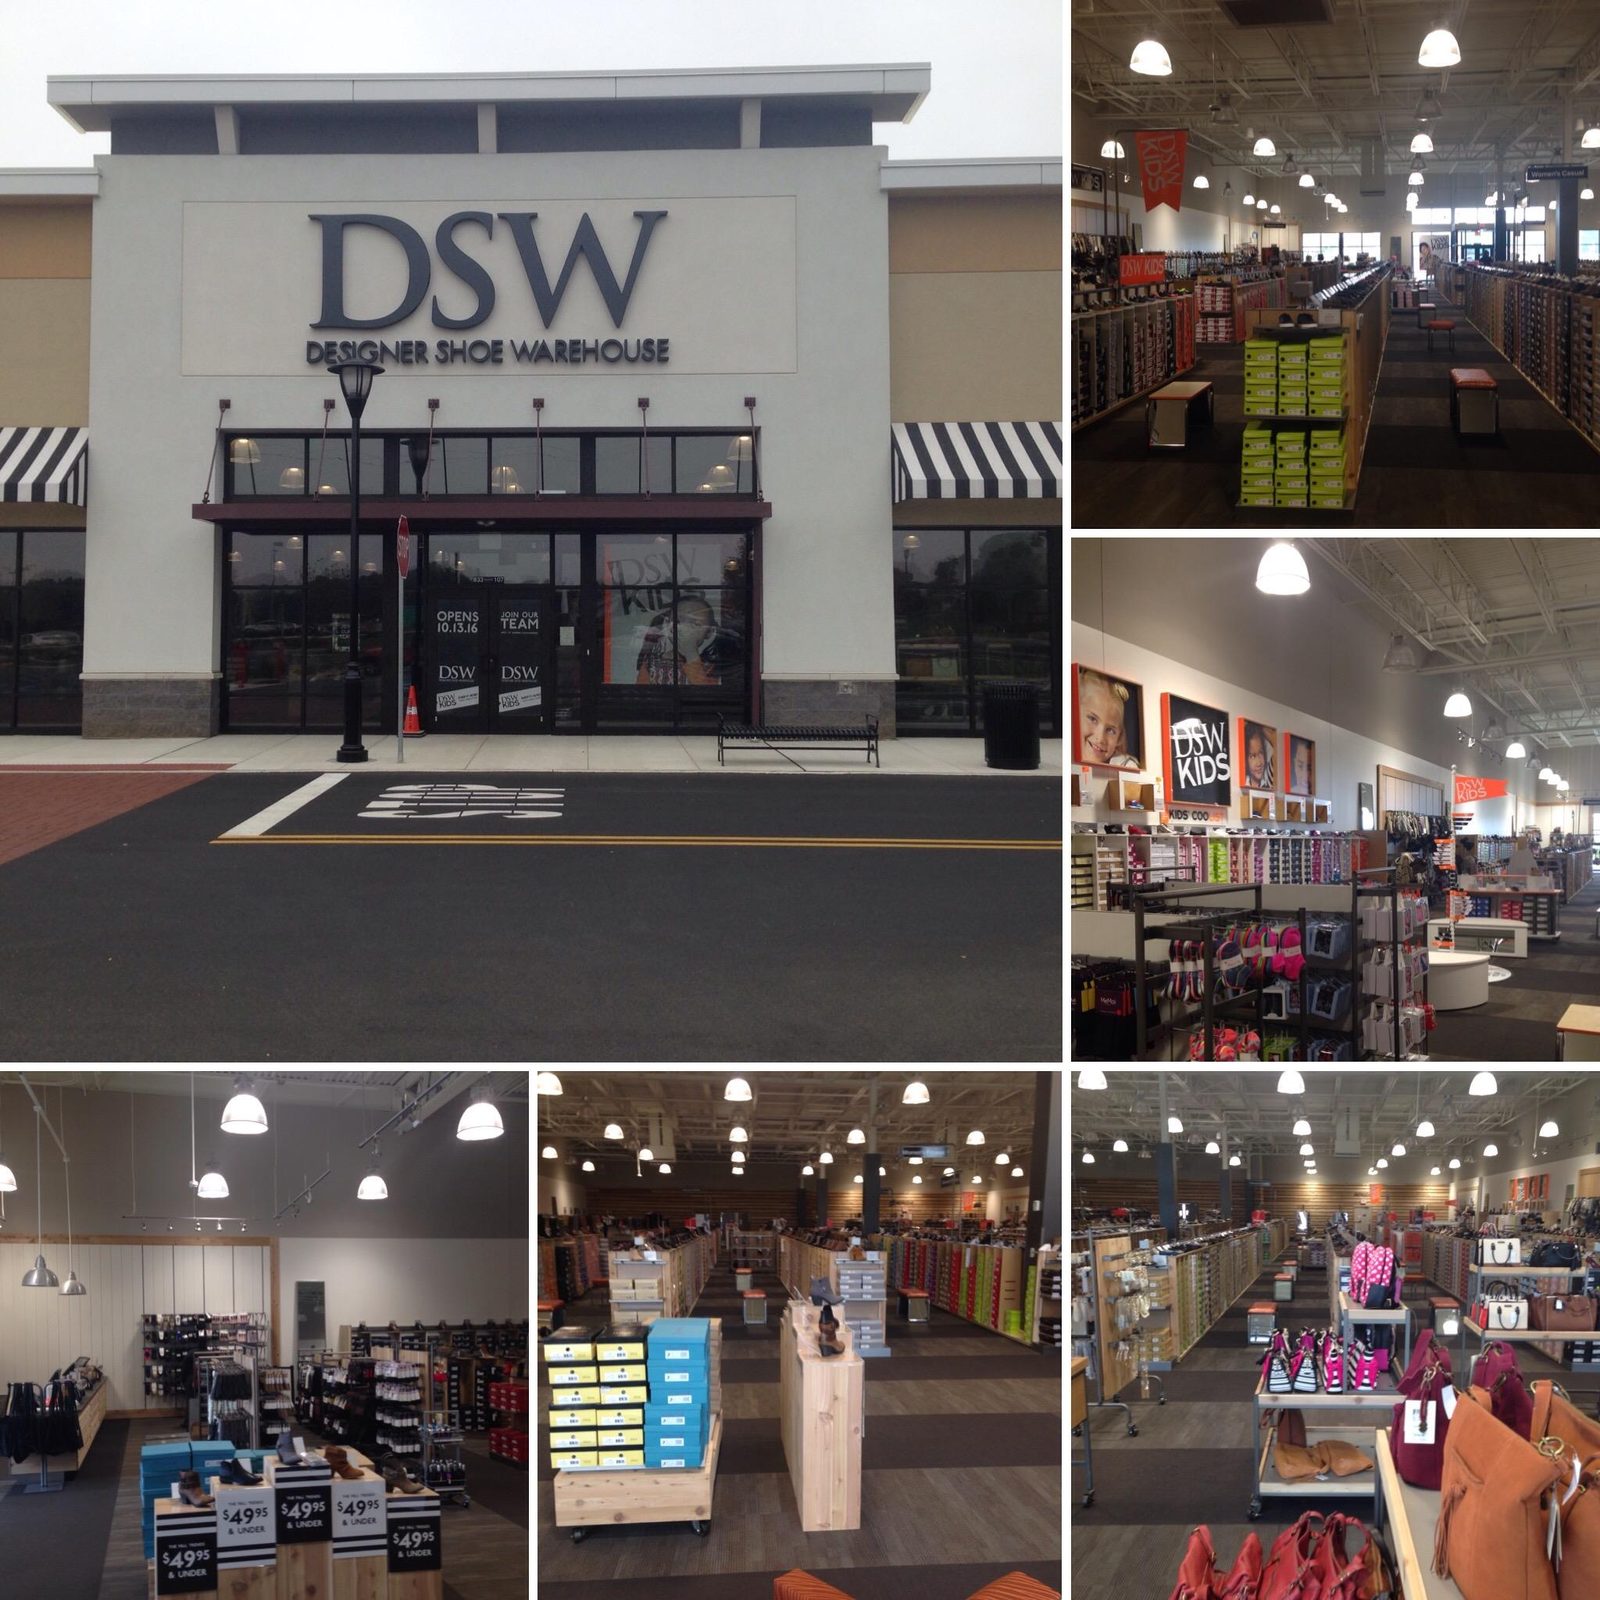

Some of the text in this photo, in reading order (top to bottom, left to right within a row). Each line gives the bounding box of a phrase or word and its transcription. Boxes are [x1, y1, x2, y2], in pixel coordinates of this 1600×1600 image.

[1141, 139, 1165, 192] KIDS
[1155, 135, 1183, 185] DSW
[308, 211, 668, 330] DSW
[1120, 255, 1165, 278] DSW KIDS
[306, 337, 670, 365] DESIGNER SHOE WAREHOUSE
[606, 547, 697, 585] DSW
[437, 610, 479, 622] OPENS
[437, 622, 479, 633] 10.13.16
[500, 618, 539, 630] TEAM
[439, 665, 476, 679] DSW
[502, 665, 538, 680] DSW
[439, 700, 457, 708] KIDS
[1171, 721, 1225, 759] DSW
[1177, 753, 1231, 789] KIDS
[1456, 778, 1484, 791] DSW
[1457, 787, 1488, 802] KIDS
[296, 1520, 323, 1529] UNDER
[351, 1517, 376, 1526] UNDER
[237, 1526, 266, 1535] UNDER
[406, 1549, 432, 1558] UNDER
[168, 1568, 207, 1579] & UNDER
